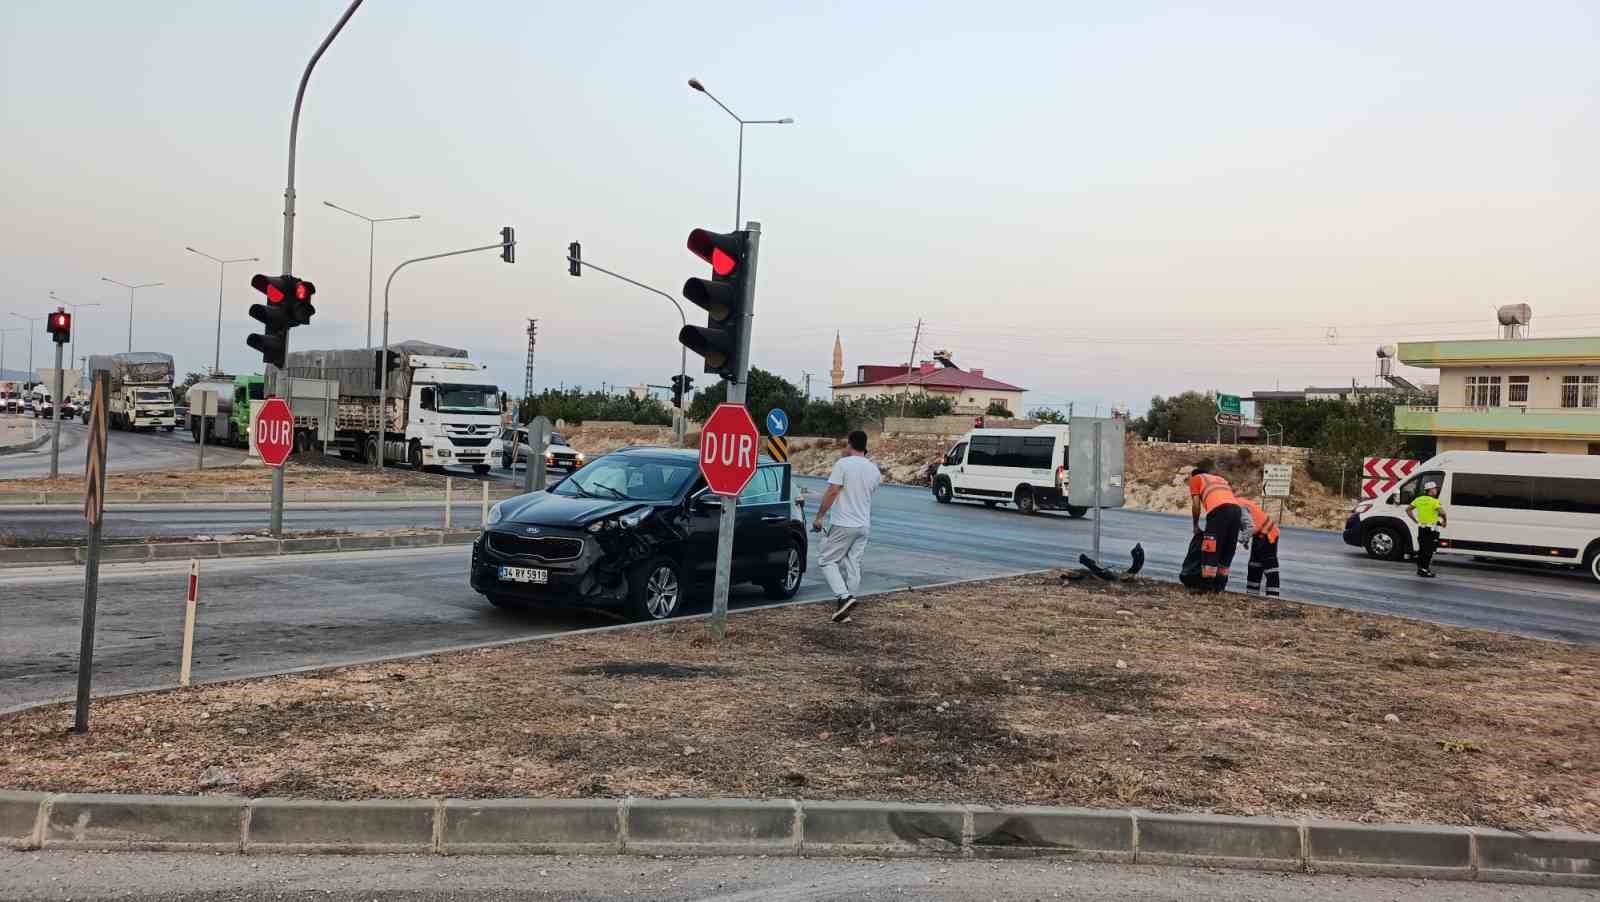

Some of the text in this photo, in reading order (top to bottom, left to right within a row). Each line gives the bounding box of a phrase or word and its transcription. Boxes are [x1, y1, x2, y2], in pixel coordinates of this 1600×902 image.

[258, 419, 290, 446] DUR
[704, 432, 752, 468] DUR
[503, 567, 513, 577] 34
